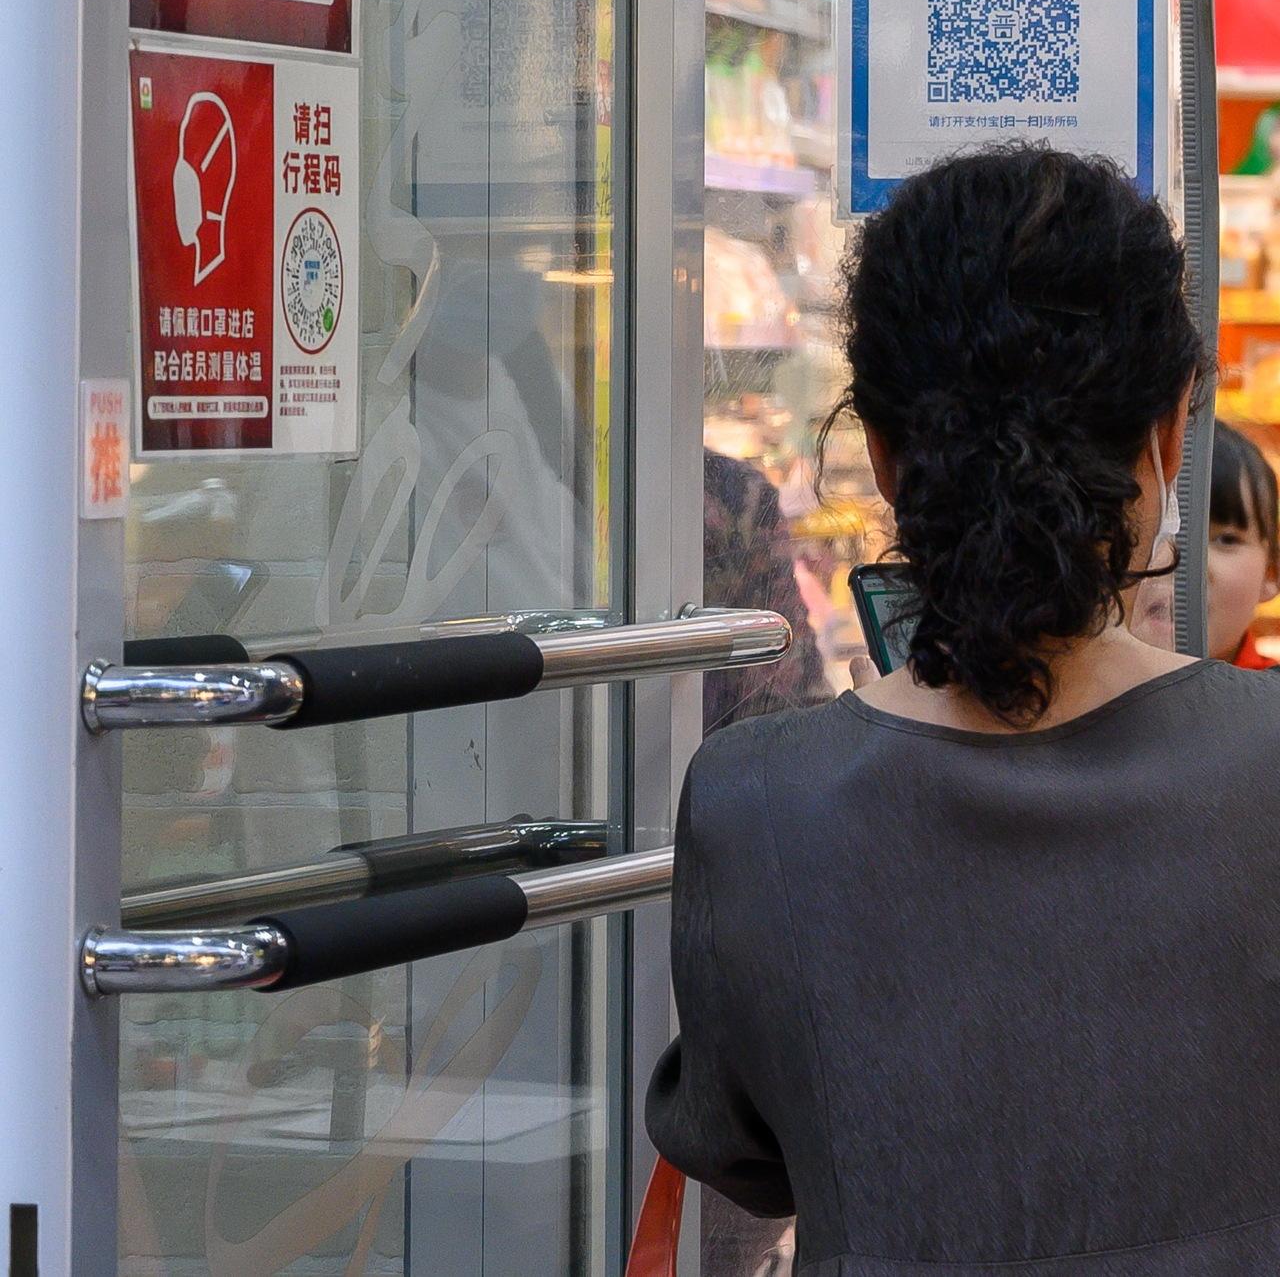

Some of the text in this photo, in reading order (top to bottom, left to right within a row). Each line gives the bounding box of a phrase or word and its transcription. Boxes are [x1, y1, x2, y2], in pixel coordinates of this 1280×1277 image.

[293, 101, 331, 146] 请扫
[928, 114, 1079, 128] 请打开支付宝[扫一扫]场所码
[283, 150, 341, 197] 行程码
[159, 306, 255, 339] 请佩戴口罩进店
[153, 349, 263, 383] 配合店员测量体温
